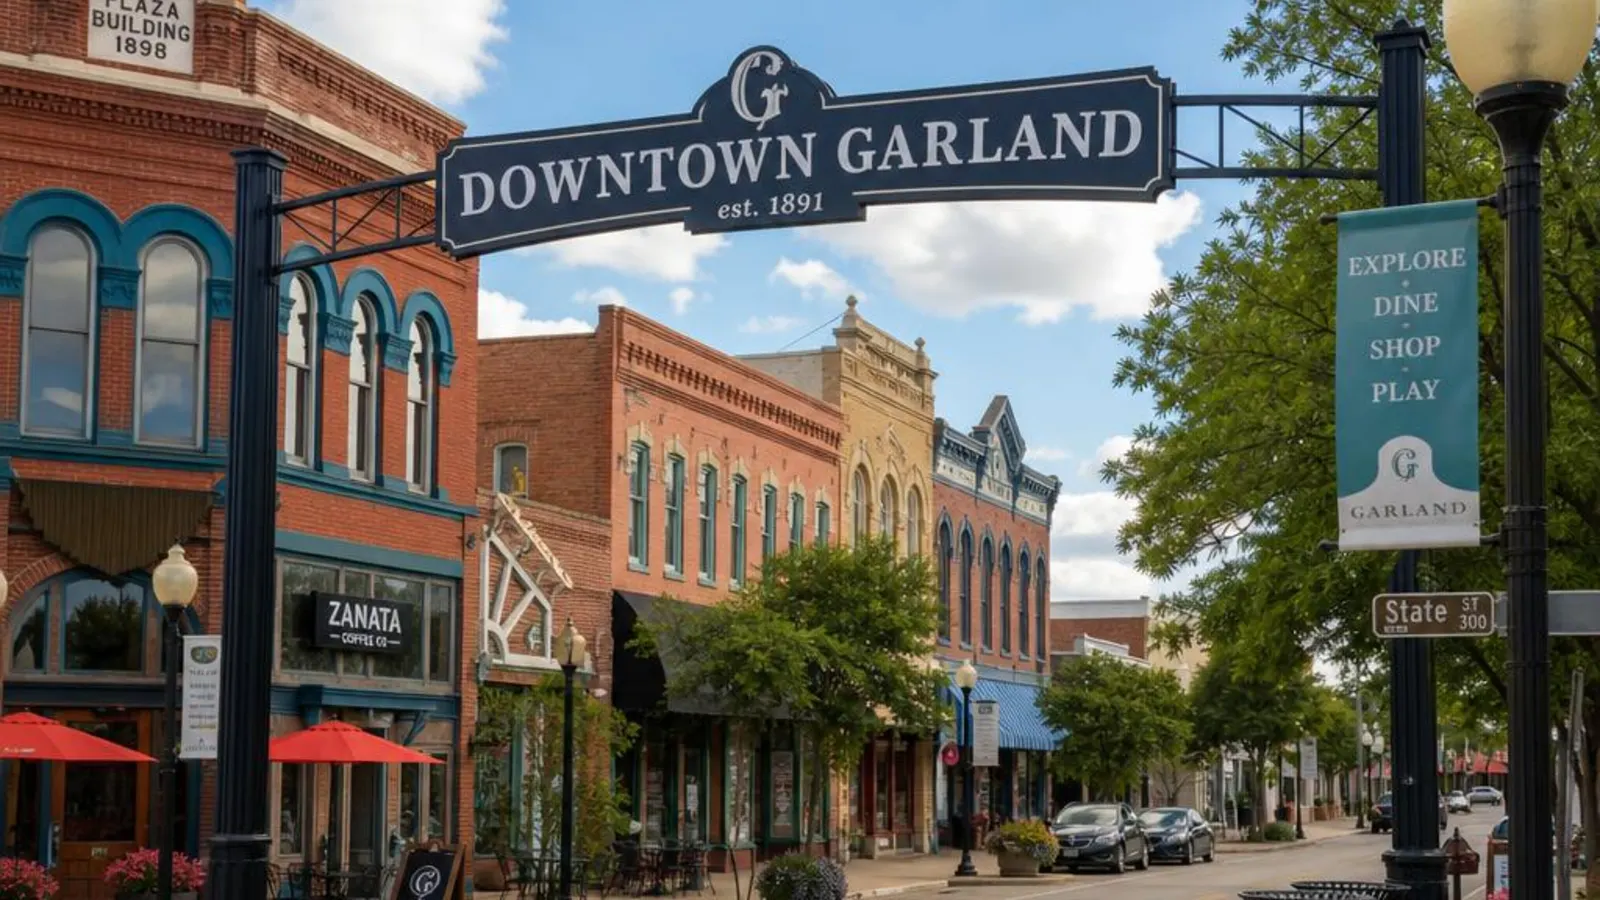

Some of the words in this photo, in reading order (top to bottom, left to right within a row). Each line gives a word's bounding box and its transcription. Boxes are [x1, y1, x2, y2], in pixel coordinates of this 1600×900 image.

[92, 9, 190, 42] BUILDING
[116, 36, 167, 59] 1898
[459, 132, 817, 217] DOWNTOWN
[837, 110, 1142, 174] GARLAND
[717, 199, 758, 219] est.
[768, 192, 824, 215] 1891
[1348, 248, 1467, 276] EXPLORE
[1374, 292, 1438, 317] DINE
[1370, 336, 1441, 360] SHOP
[1372, 379, 1440, 403] PLAY
[1350, 501, 1467, 519] GARLAND
[328, 601, 402, 634] ZANATA
[1385, 600, 1448, 623] State
[1462, 597, 1479, 612] ST
[1459, 614, 1487, 630] 300
